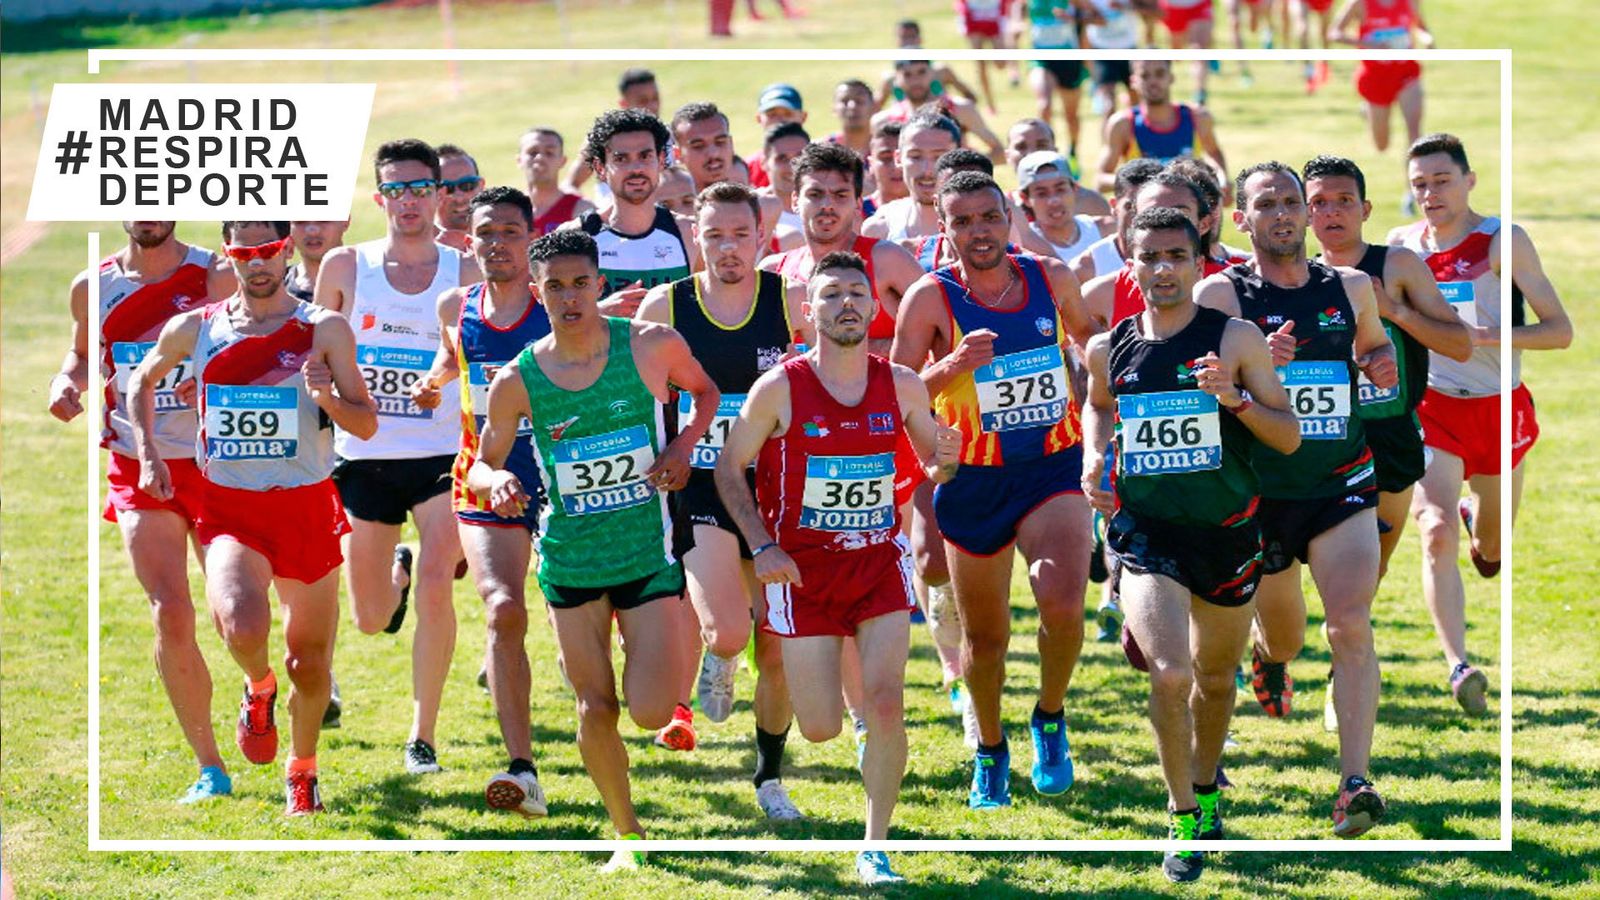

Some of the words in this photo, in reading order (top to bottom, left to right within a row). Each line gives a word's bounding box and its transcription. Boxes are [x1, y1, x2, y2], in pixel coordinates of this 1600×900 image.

[994, 372, 1057, 408] 378
[1286, 386, 1336, 415] 65
[218, 410, 280, 437] 369
[1135, 417, 1202, 449] 466
[572, 454, 640, 490] 322
[821, 480, 882, 508] 365
